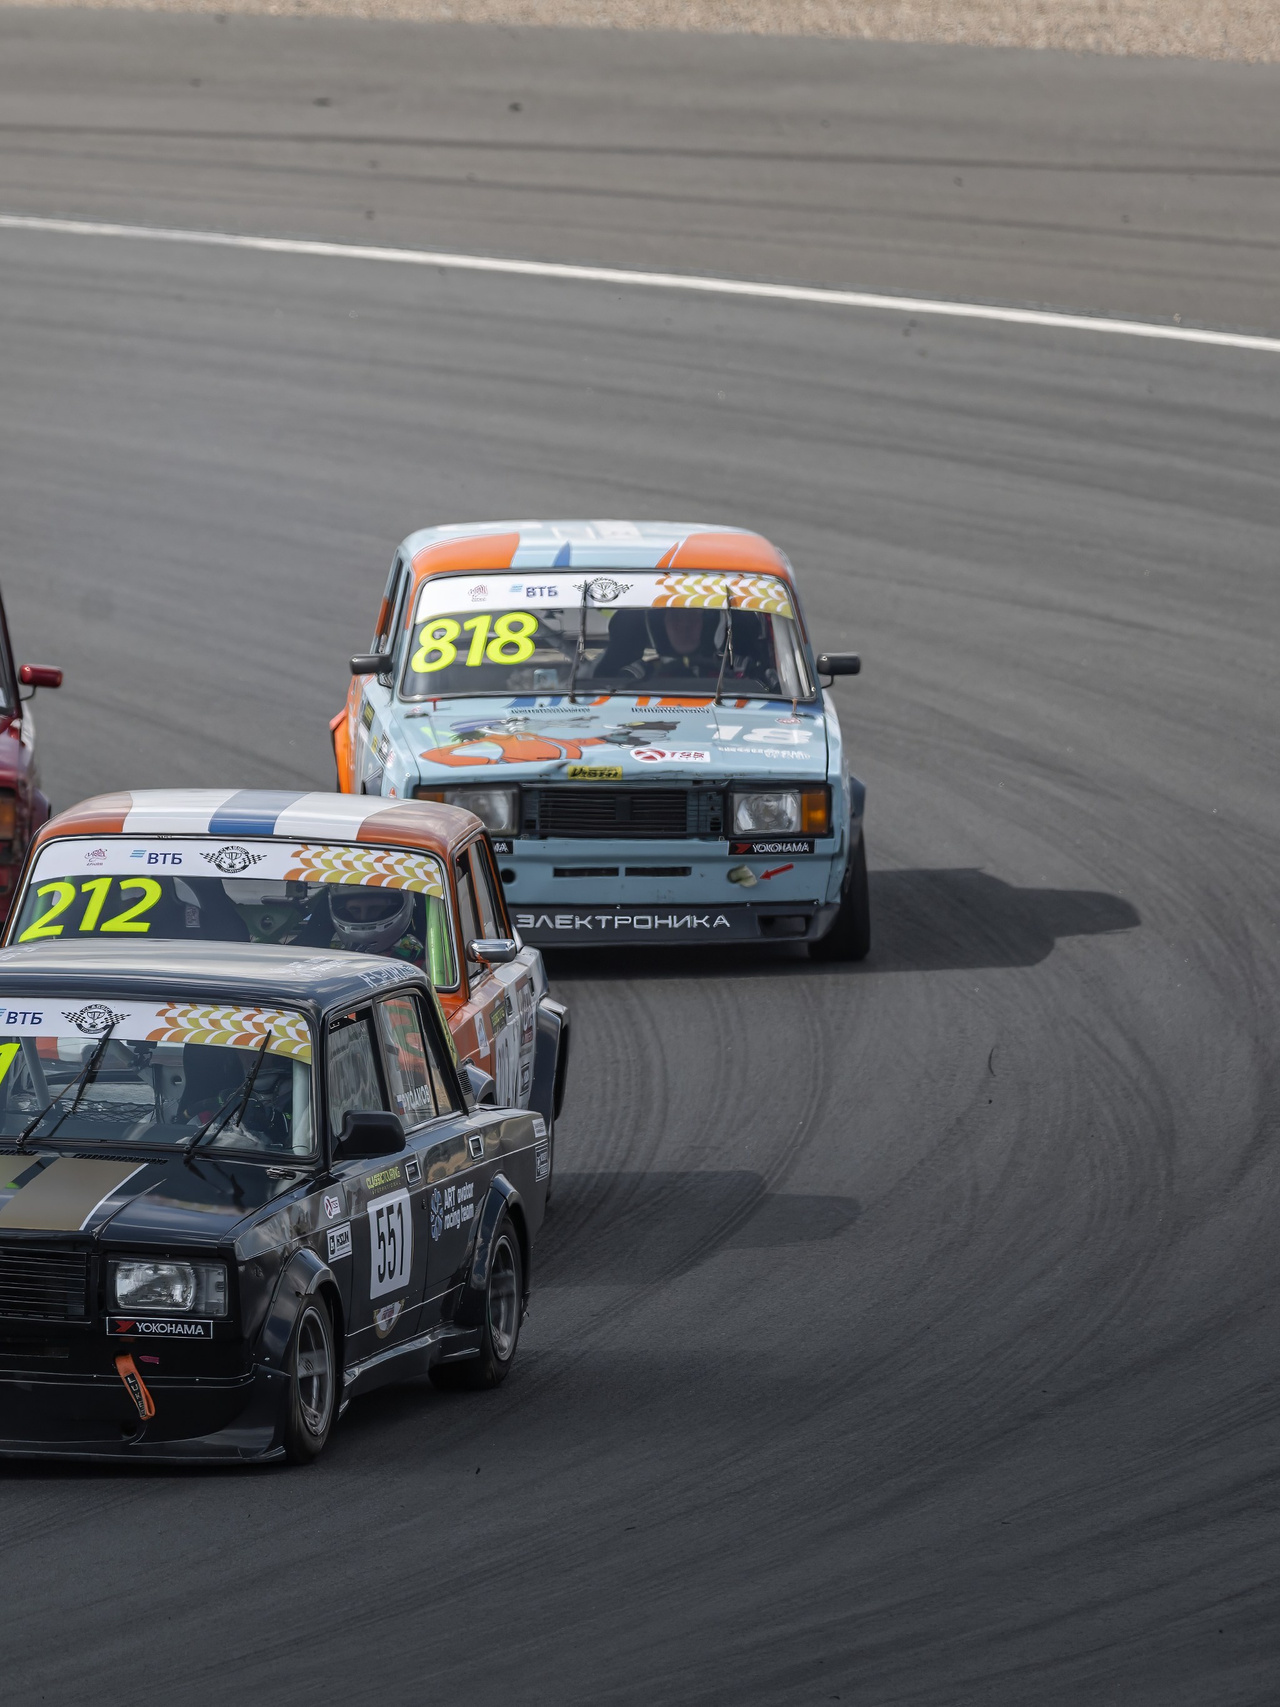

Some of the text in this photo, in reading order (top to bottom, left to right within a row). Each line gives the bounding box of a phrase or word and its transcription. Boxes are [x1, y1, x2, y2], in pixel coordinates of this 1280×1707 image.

[526, 585, 558, 598] ВТБ
[411, 612, 539, 673] 818
[752, 842, 810, 853] YOKOHAMA
[147, 852, 183, 865] ВТБ
[19, 877, 162, 942] 212
[516, 914, 731, 931] ЭЛЕКТРОНИКА
[5, 1010, 44, 1025] ВТБ
[376, 1202, 405, 1284] 551
[136, 1321, 205, 1335] YOKOHAMA
